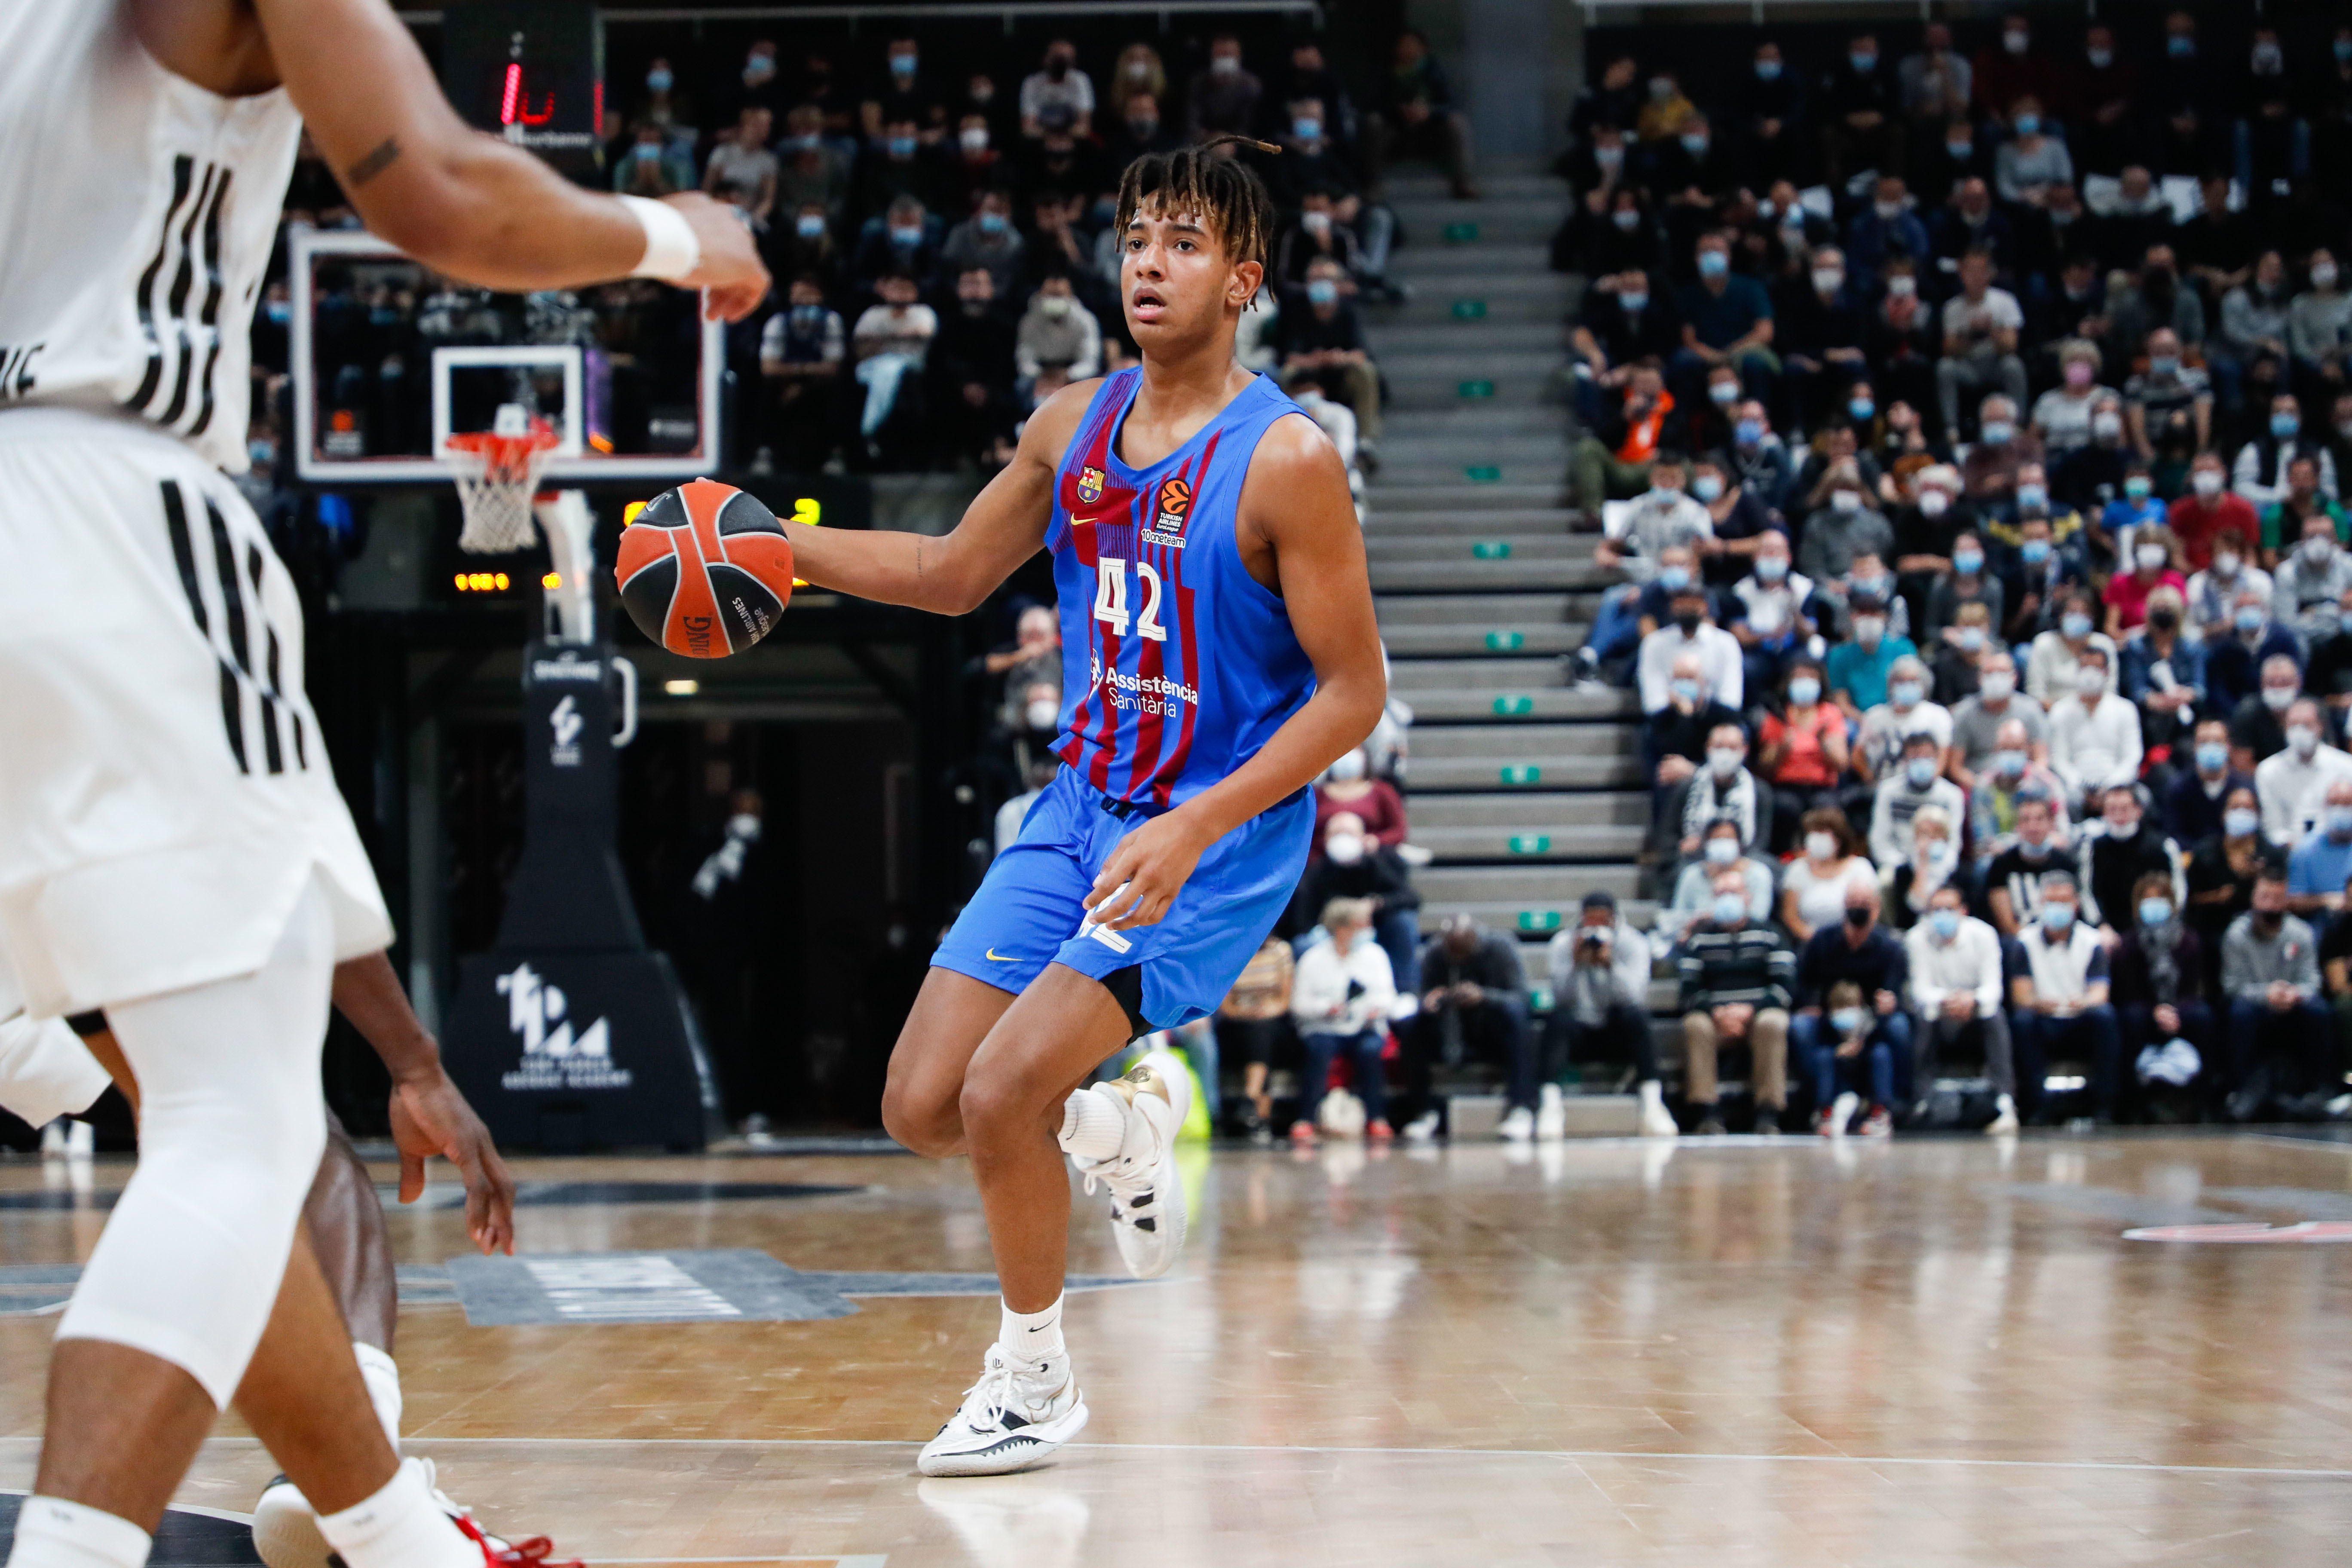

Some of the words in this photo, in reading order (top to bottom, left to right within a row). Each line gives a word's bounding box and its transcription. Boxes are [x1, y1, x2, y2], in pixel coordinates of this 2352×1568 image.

[1158, 518, 1181, 527] AIRLINES
[1160, 512, 1183, 521] TURKISH
[732, 597, 757, 633] AIRLINES
[1094, 556, 1167, 641] 42
[683, 616, 712, 655] DING
[1106, 667, 1198, 705] Assistència
[1108, 687, 1176, 718] Sanitària
